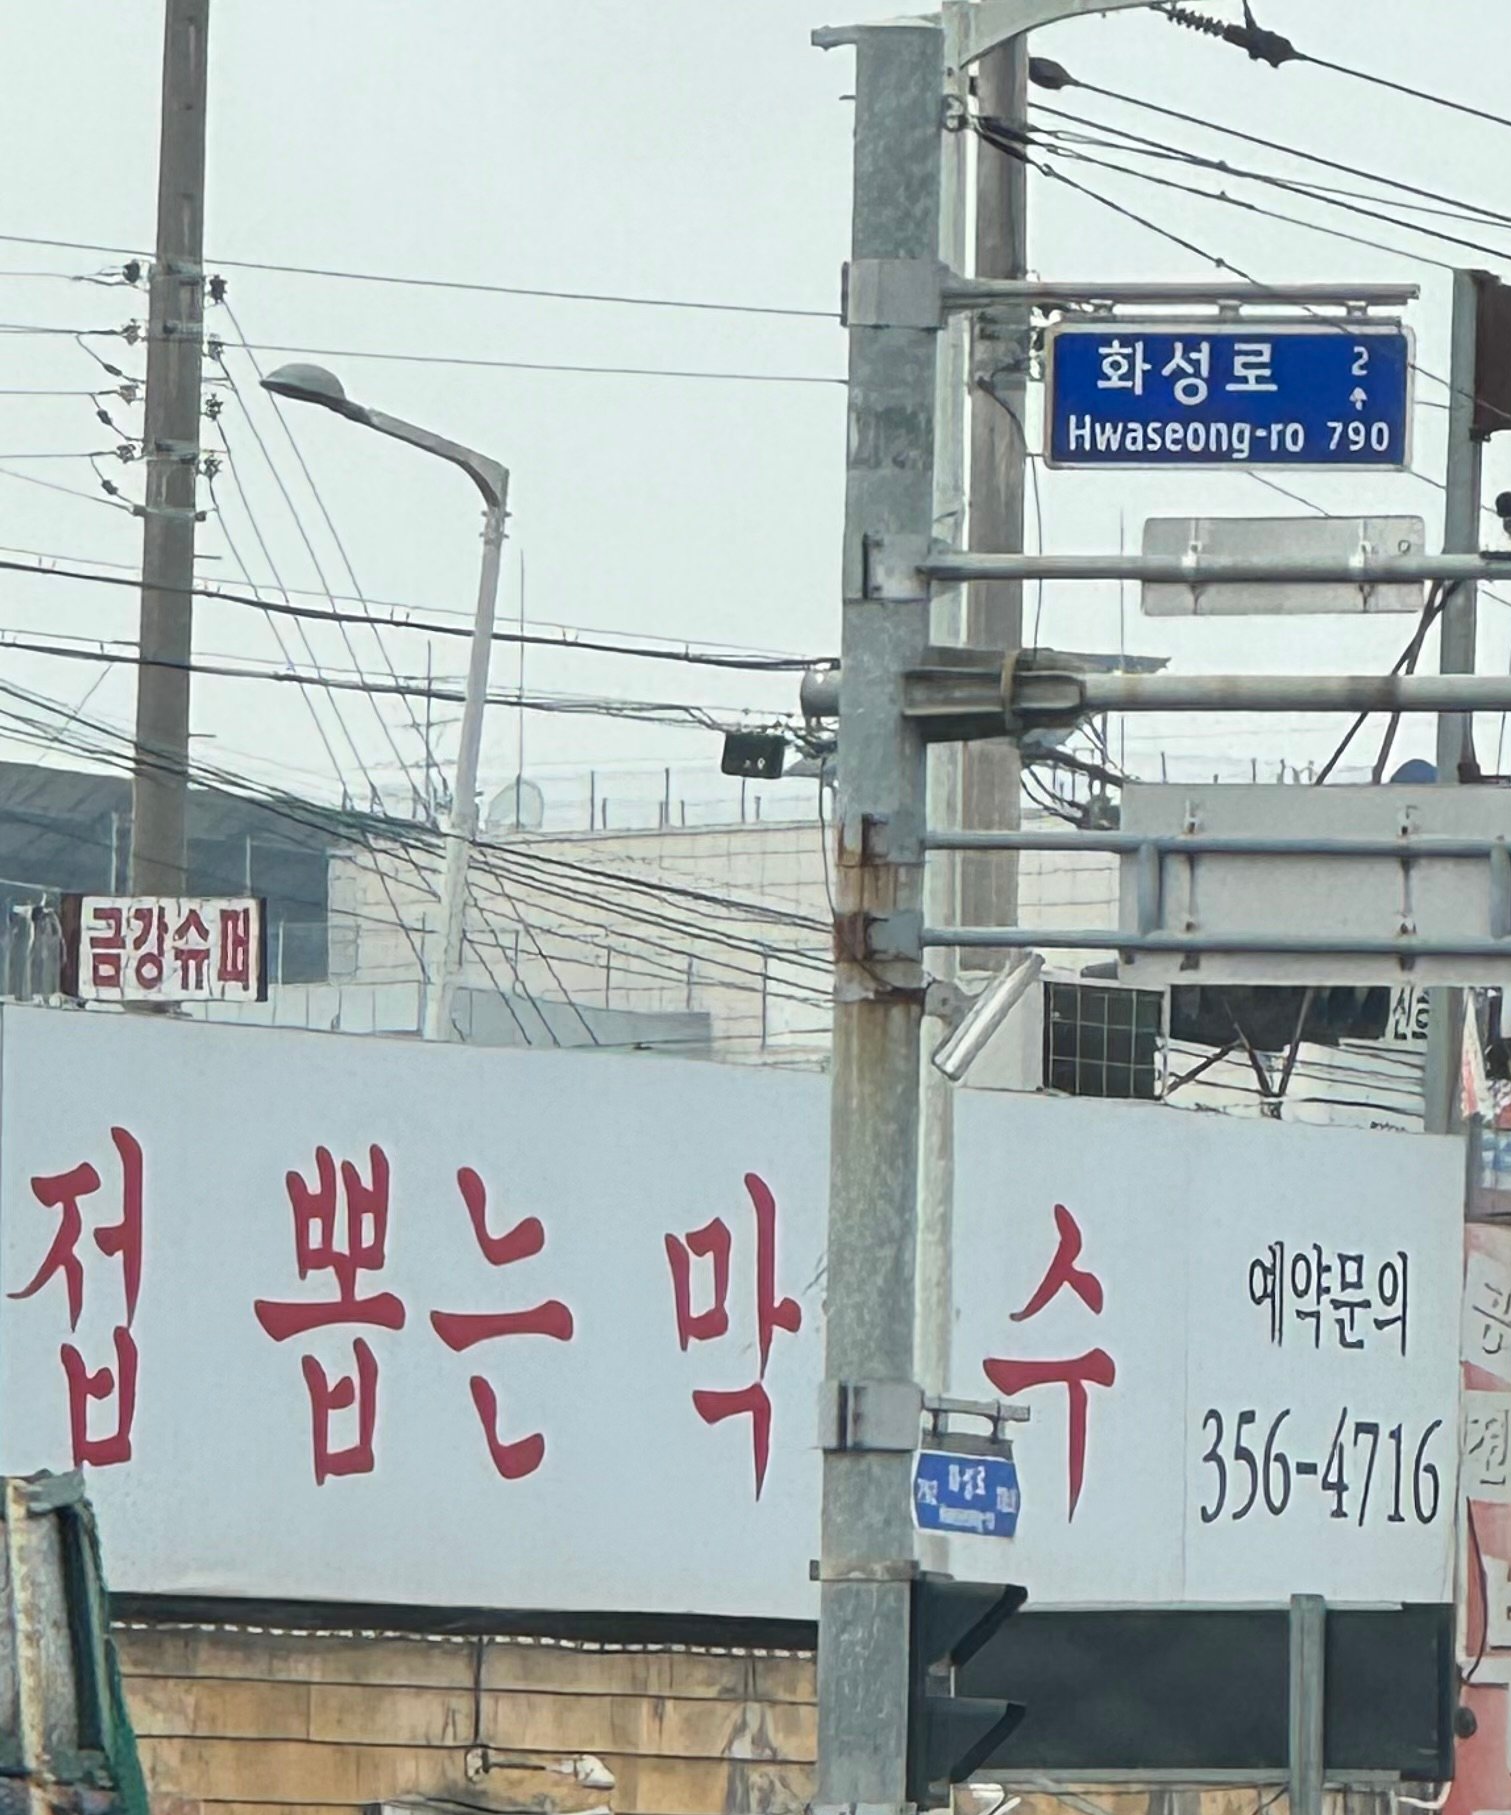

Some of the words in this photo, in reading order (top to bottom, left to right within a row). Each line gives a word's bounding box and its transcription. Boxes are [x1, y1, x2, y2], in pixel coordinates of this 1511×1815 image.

[1096, 339, 1279, 406] 화성로
[1351, 346, 1370, 376] 2
[1068, 413, 1306, 460] Hwaseong-ro
[1326, 420, 1390, 451] 790
[89, 905, 251, 991] 금강슈퍼
[254, 1143, 574, 1486] 뽑는
[1249, 1240, 1410, 1357] 예약문의
[1200, 1404, 1444, 1527] 356-4716
